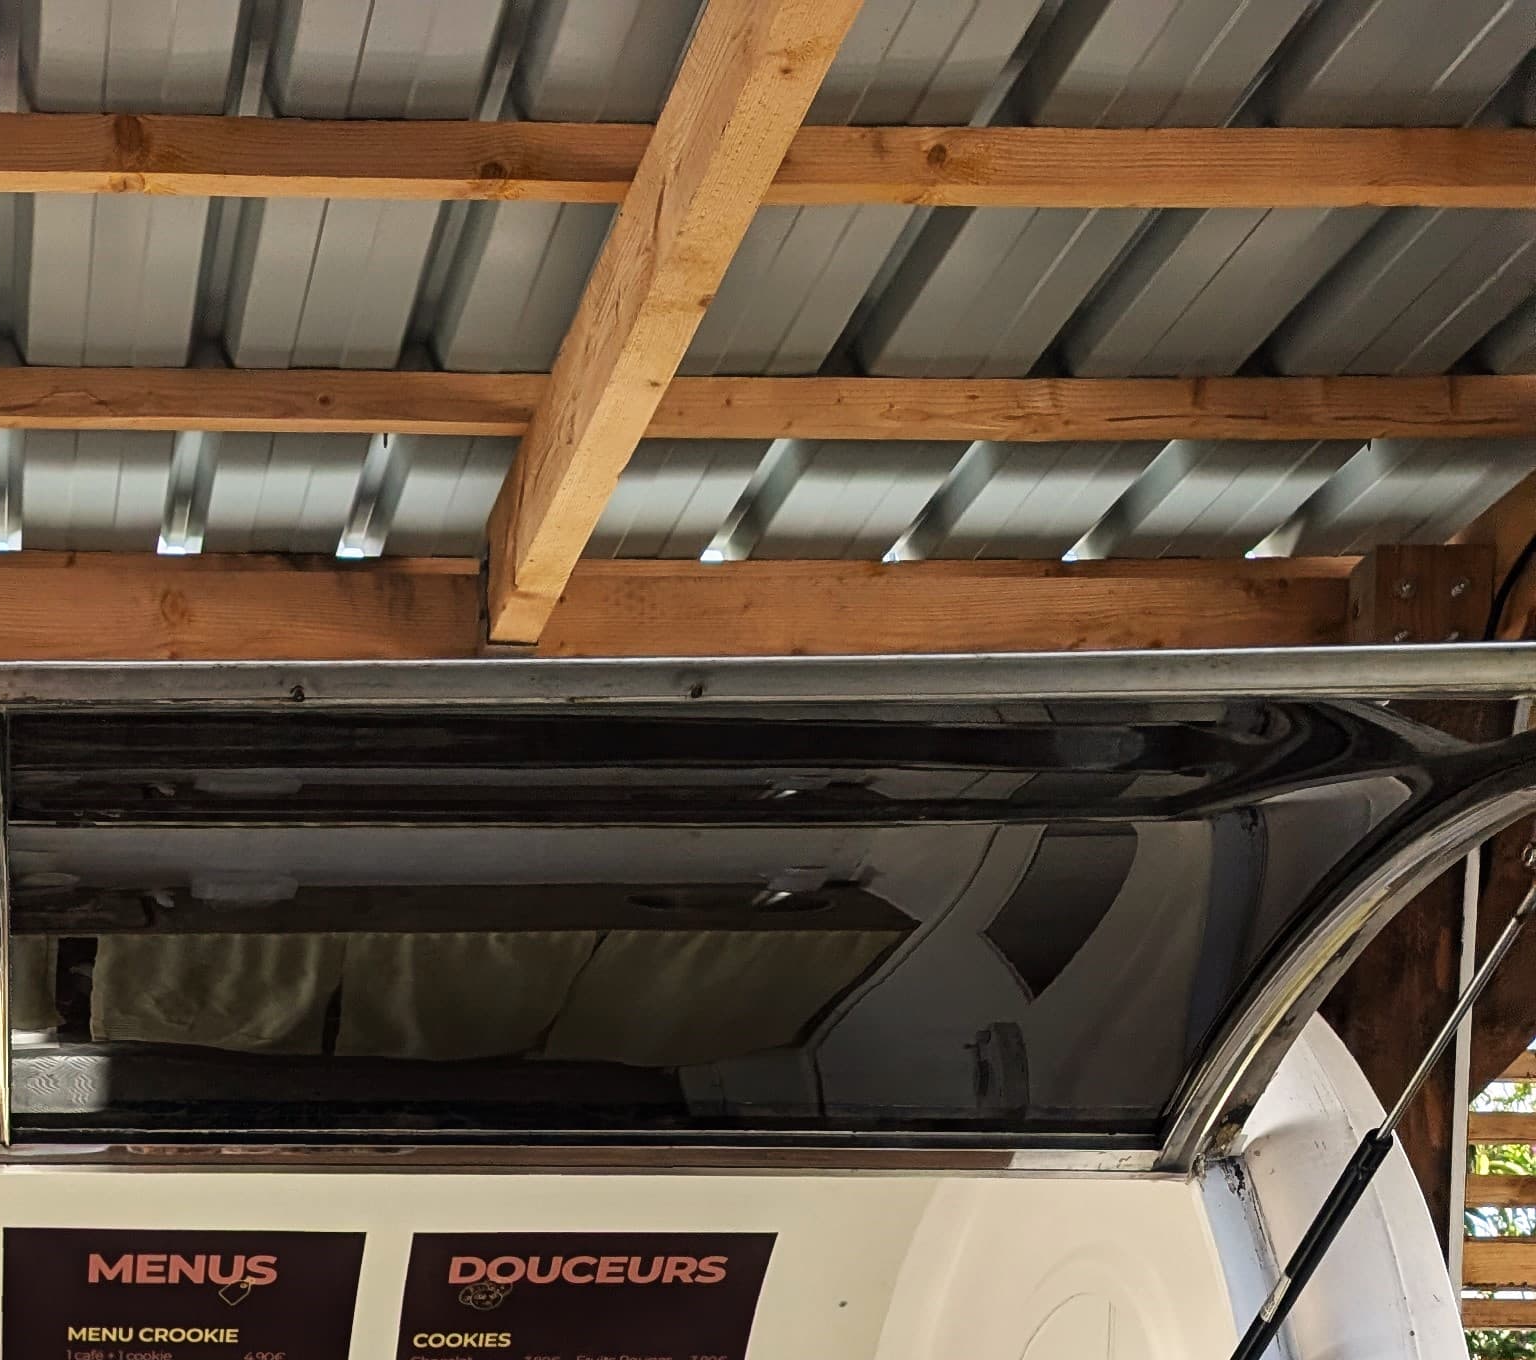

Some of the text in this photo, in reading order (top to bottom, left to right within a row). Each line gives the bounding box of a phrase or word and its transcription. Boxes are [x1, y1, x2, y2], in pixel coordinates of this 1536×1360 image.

[87, 1253, 278, 1285] MENUS
[448, 1255, 728, 1284] DOUCEURS
[68, 1327, 238, 1342] MENU CROOKIE
[413, 1333, 511, 1348] COOKIES
[74, 1350, 172, 1360] café cookie
